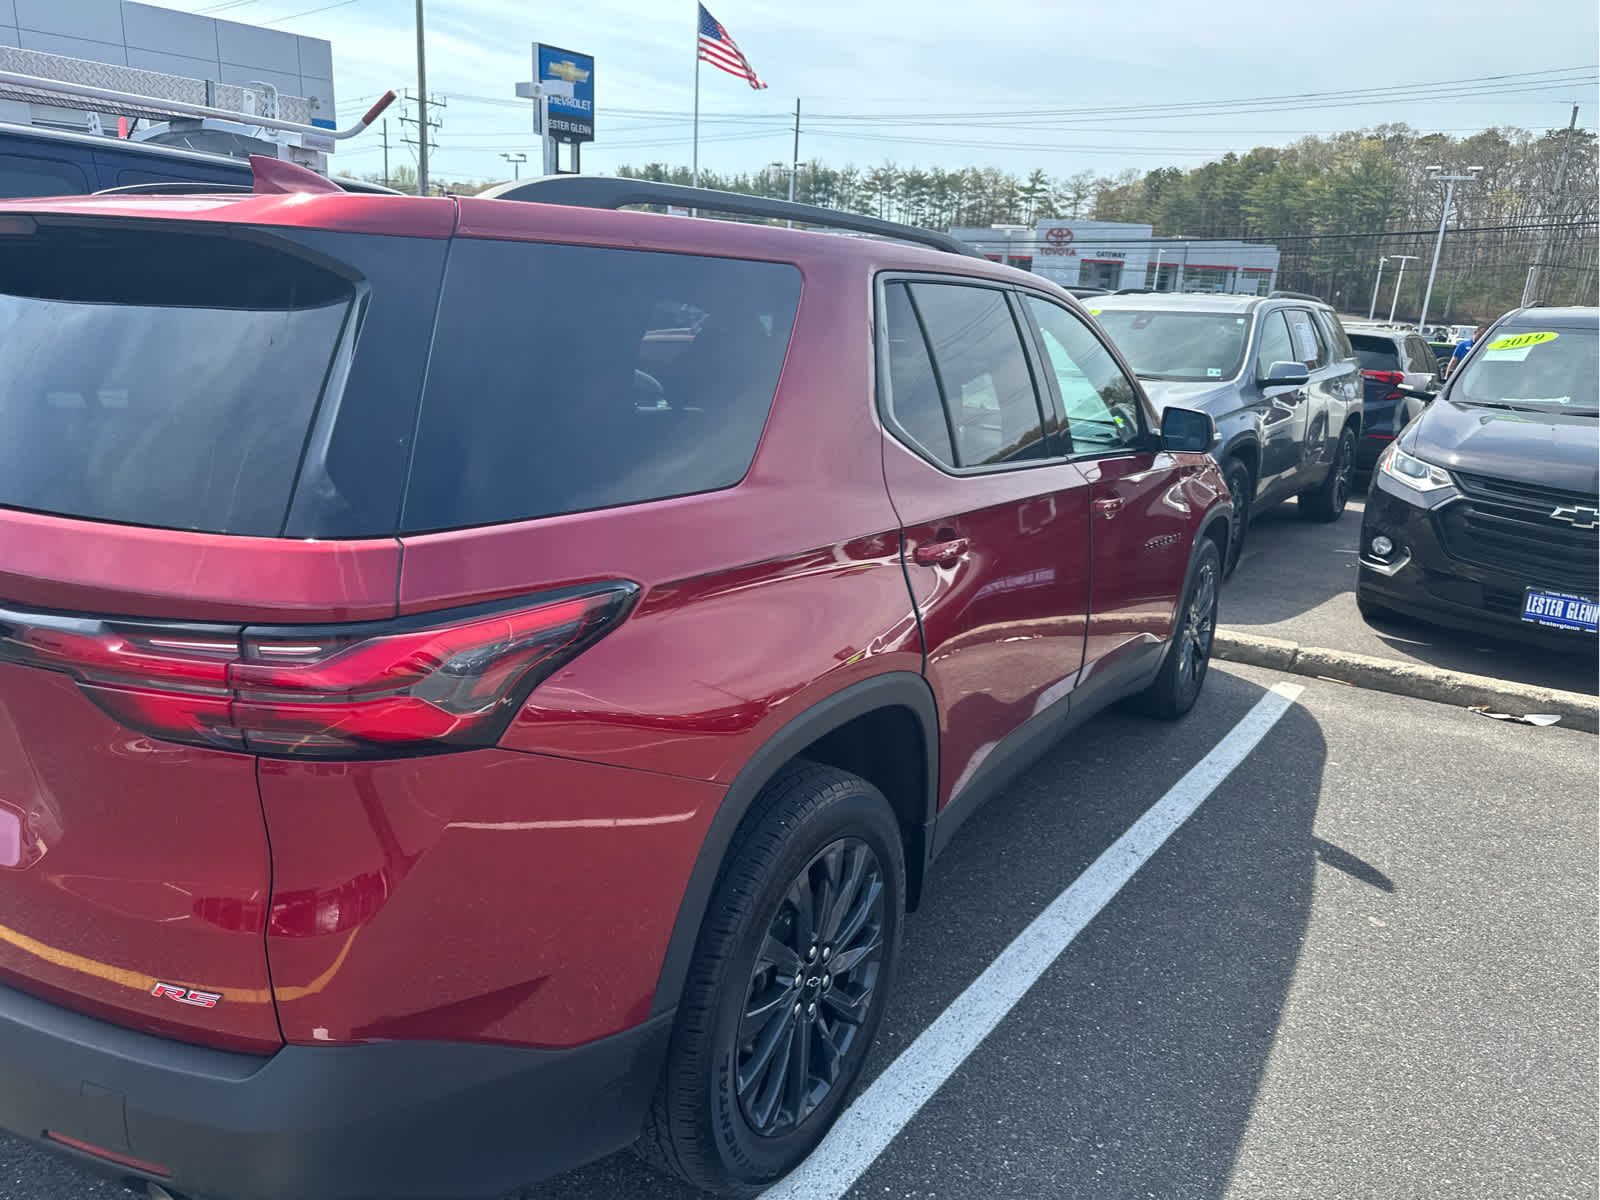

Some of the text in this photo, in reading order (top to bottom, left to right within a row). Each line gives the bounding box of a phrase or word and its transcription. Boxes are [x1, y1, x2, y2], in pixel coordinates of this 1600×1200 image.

[548, 119, 592, 135] ESTER GLENN
[1040, 247, 1077, 257] TOYOTA
[1499, 333, 1545, 349] 2019
[1525, 595, 1565, 617] LESTER
[1566, 602, 1599, 624] GLENN
[151, 982, 223, 1008] RS
